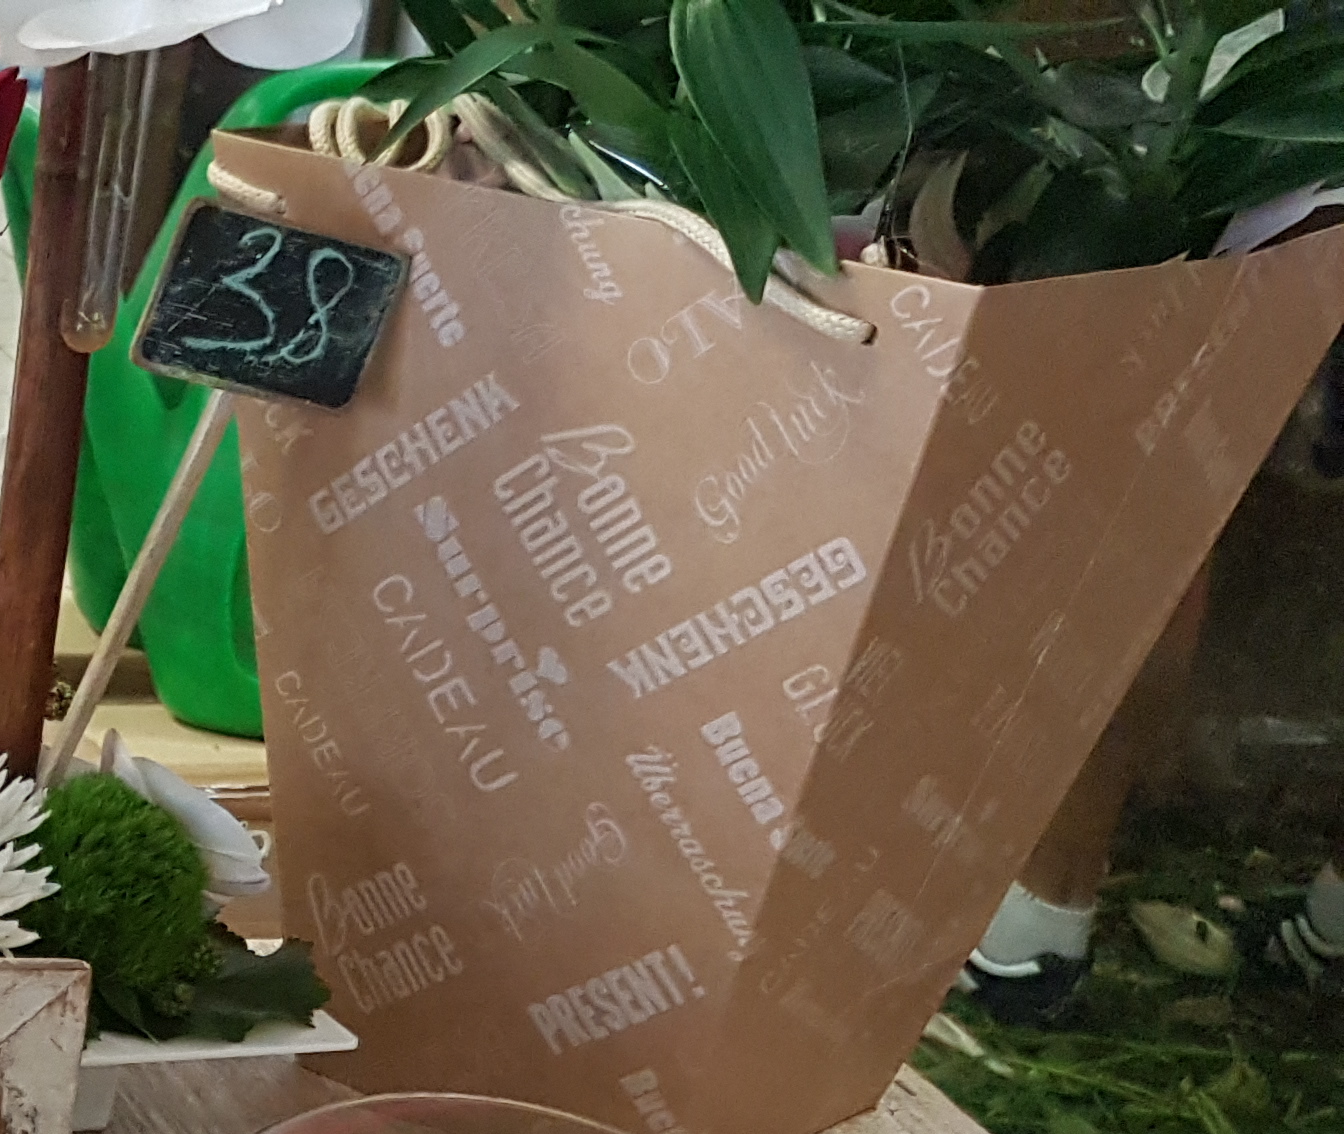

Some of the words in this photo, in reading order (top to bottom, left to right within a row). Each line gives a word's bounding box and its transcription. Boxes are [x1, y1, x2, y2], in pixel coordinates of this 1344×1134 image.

[181, 226, 355, 364] 38
[308, 374, 521, 535] GESCHENK
[539, 424, 673, 593] Bonne
[695, 415, 775, 544] Good
[909, 420, 1047, 604] Bonne
[933, 449, 1073, 617] Chance
[493, 454, 613, 627] Chance
[606, 537, 869, 698] GESCHENK
[372, 573, 519, 793] CADEAU
[414, 496, 571, 750] Surprise
[275, 671, 371, 816] CADEAU
[701, 711, 786, 825] Buena
[307, 863, 428, 957] Bonne
[337, 925, 463, 1015] Chance
[528, 945, 706, 1056] PRESENT!
